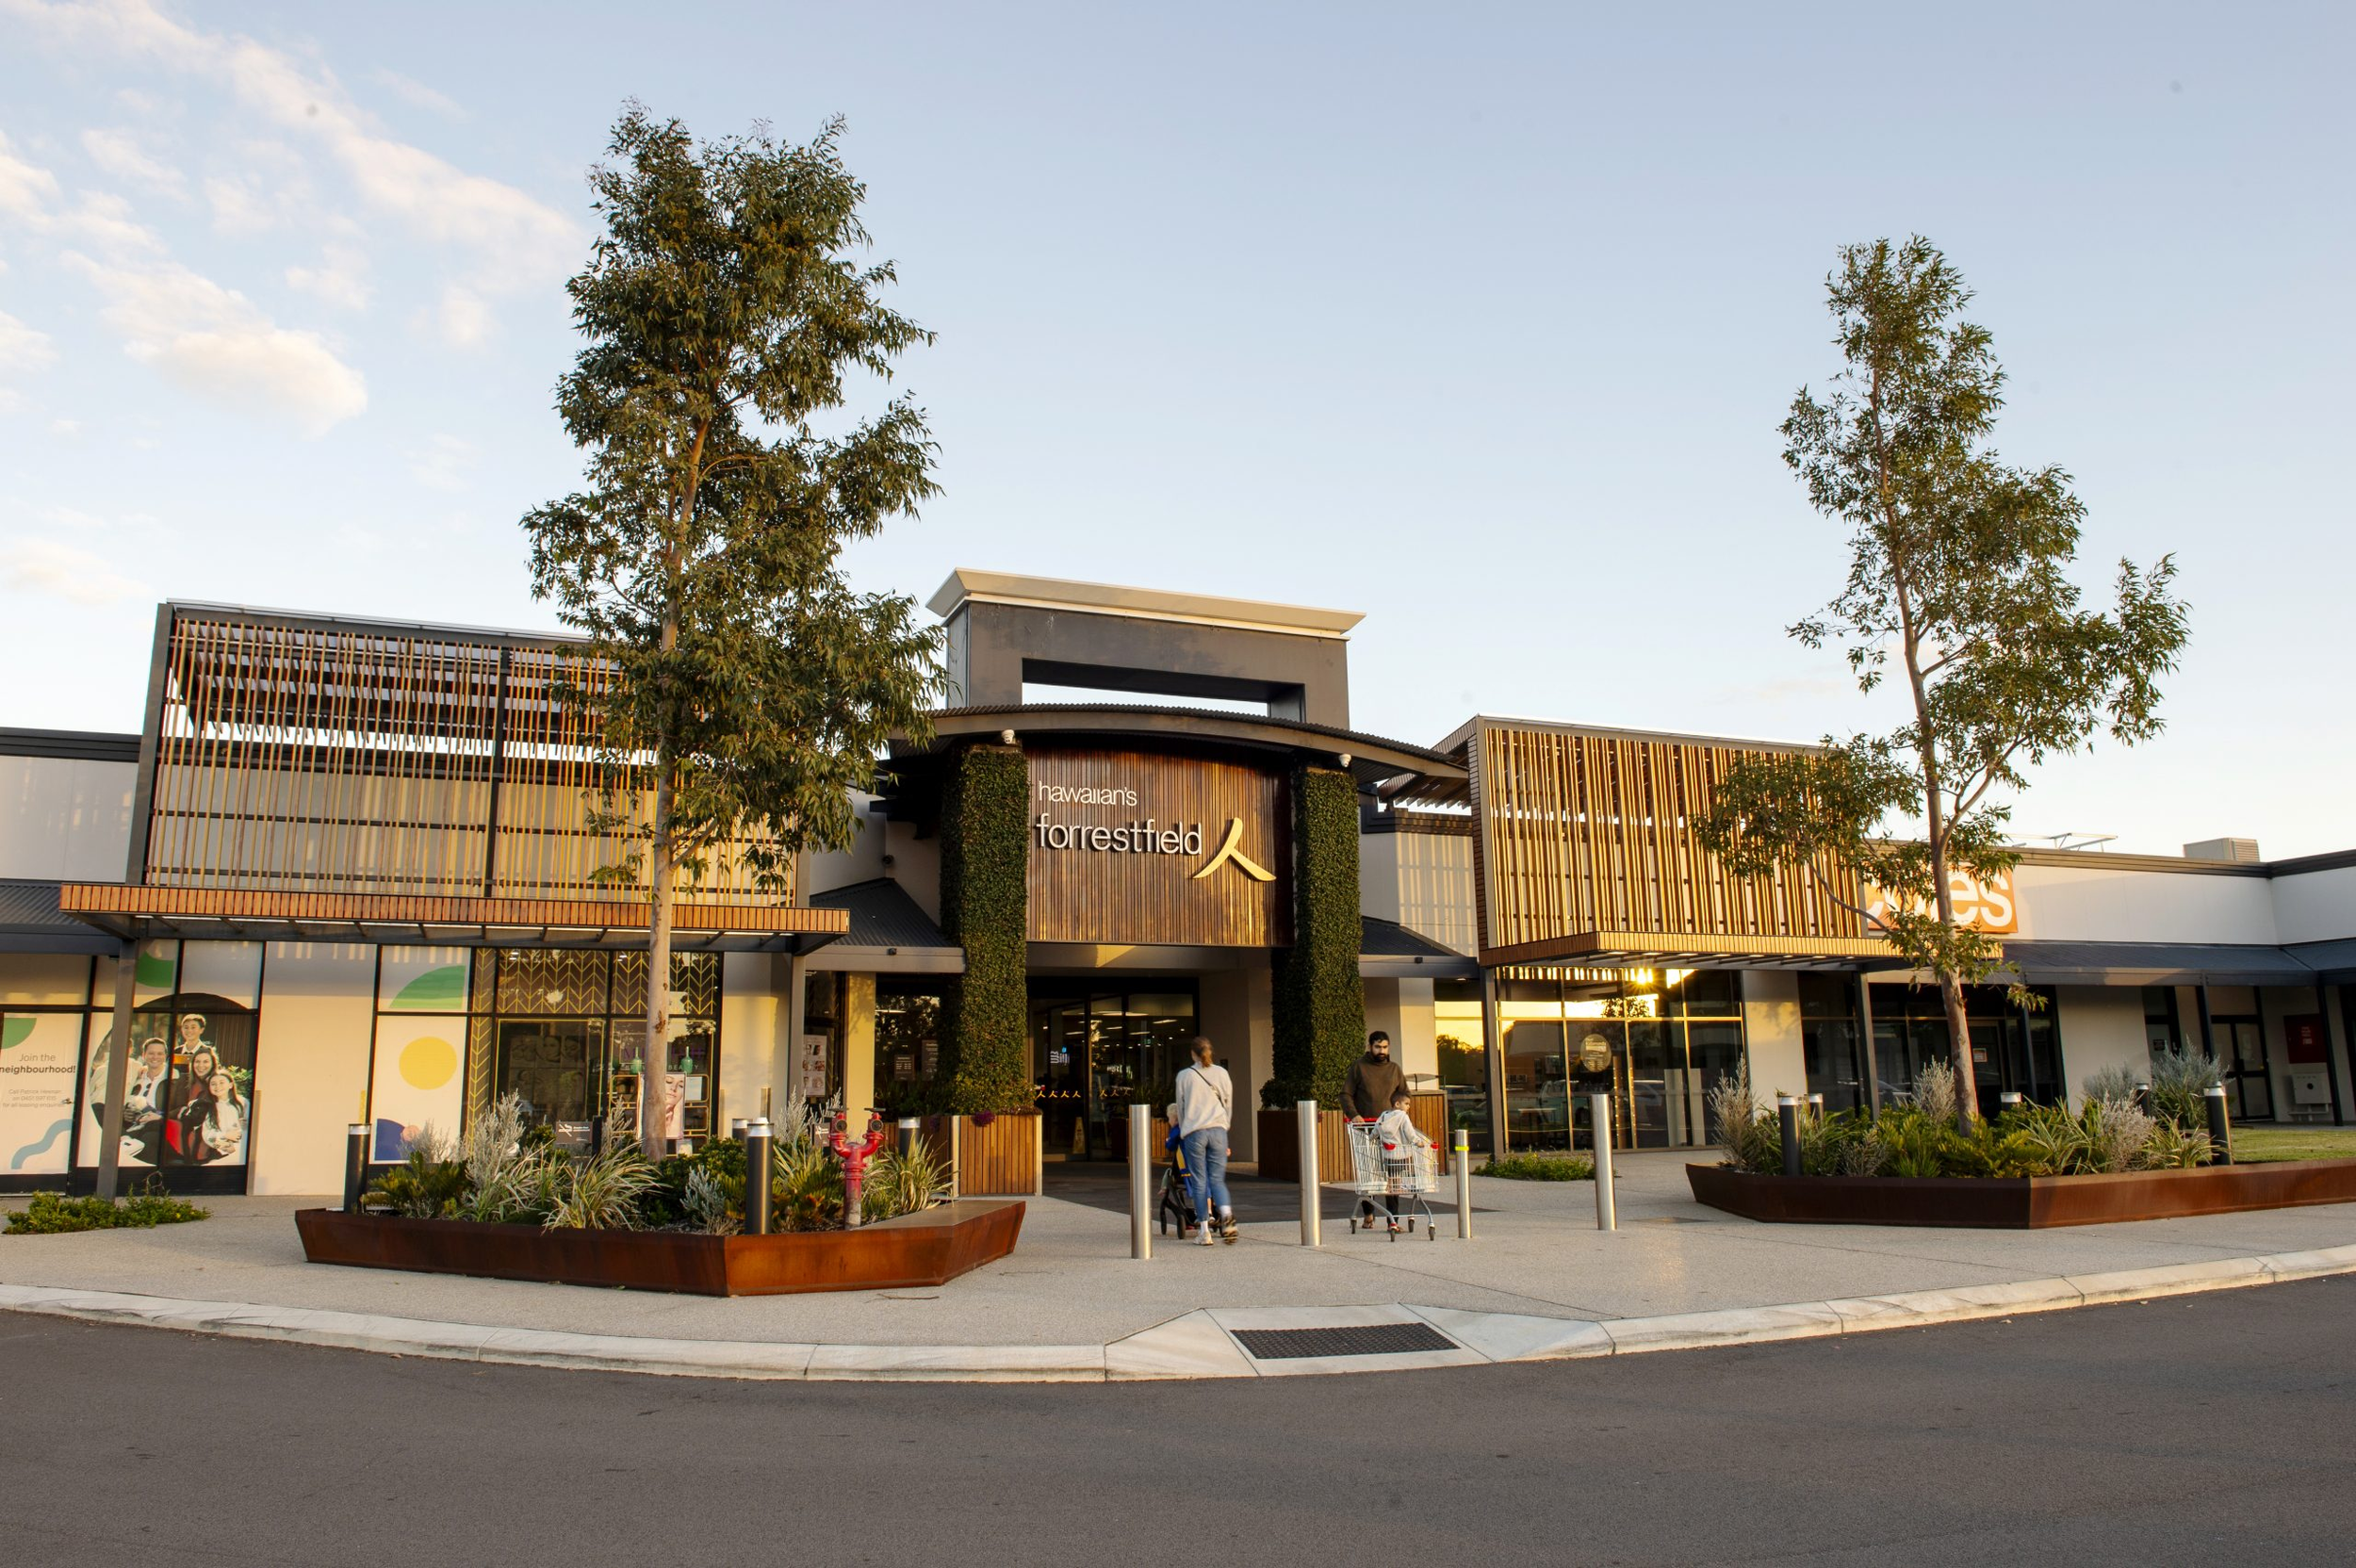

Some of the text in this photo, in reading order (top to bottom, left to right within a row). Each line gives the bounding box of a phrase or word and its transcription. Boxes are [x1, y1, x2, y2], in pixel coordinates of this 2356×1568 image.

[1039, 780, 1137, 807] hawaiian's
[1036, 812, 1203, 855] forrestfield
[19, 1053, 56, 1062] Join the
[0, 1065, 76, 1075] neighbourhood!
